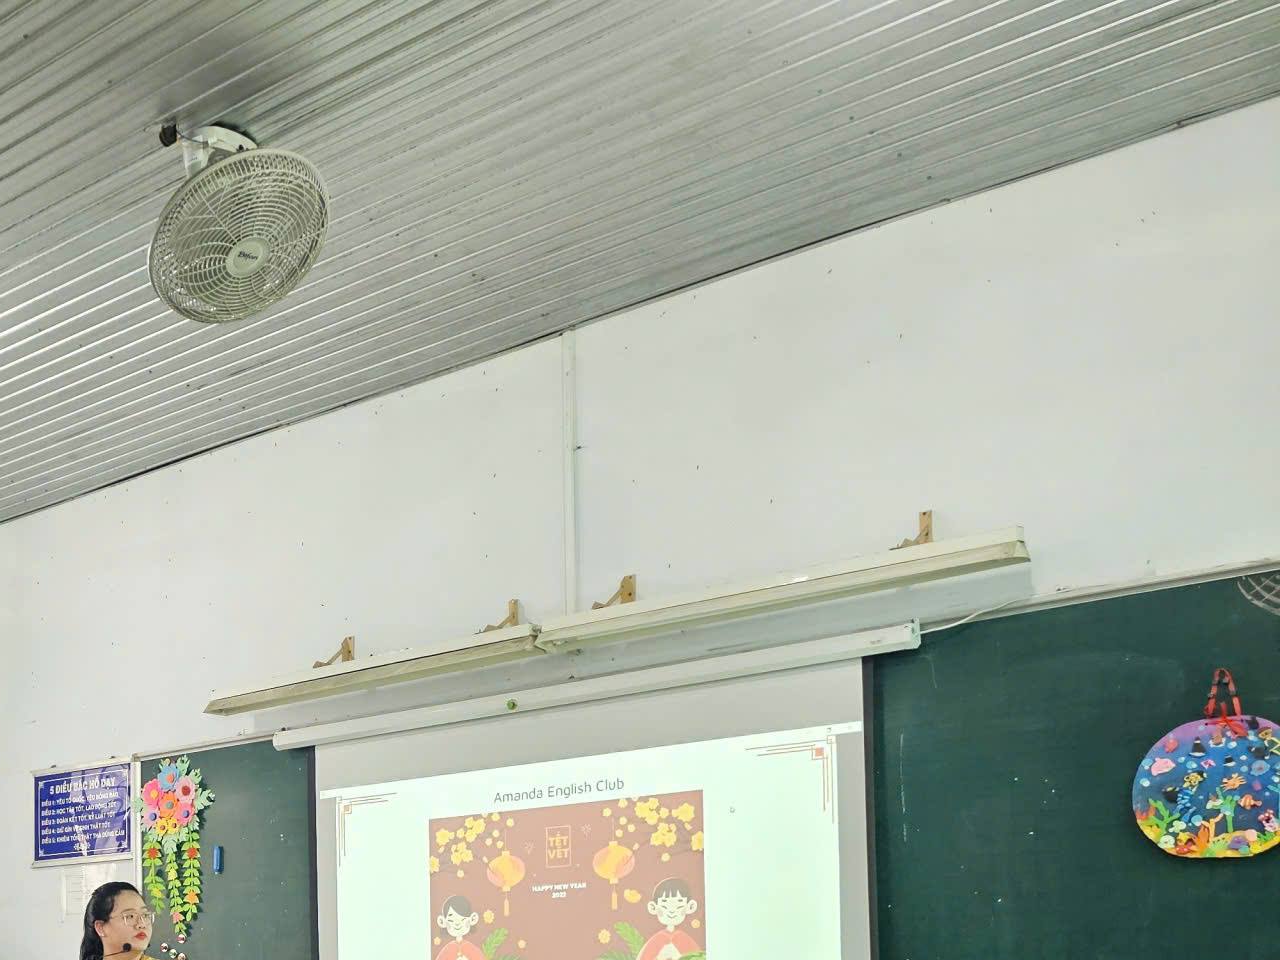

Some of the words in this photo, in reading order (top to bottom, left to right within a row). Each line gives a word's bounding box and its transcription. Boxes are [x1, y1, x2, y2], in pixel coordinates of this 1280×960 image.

[50, 786, 54, 795] 5
[494, 788, 543, 803] Amanda
[548, 782, 592, 798] English
[596, 778, 624, 791] Club
